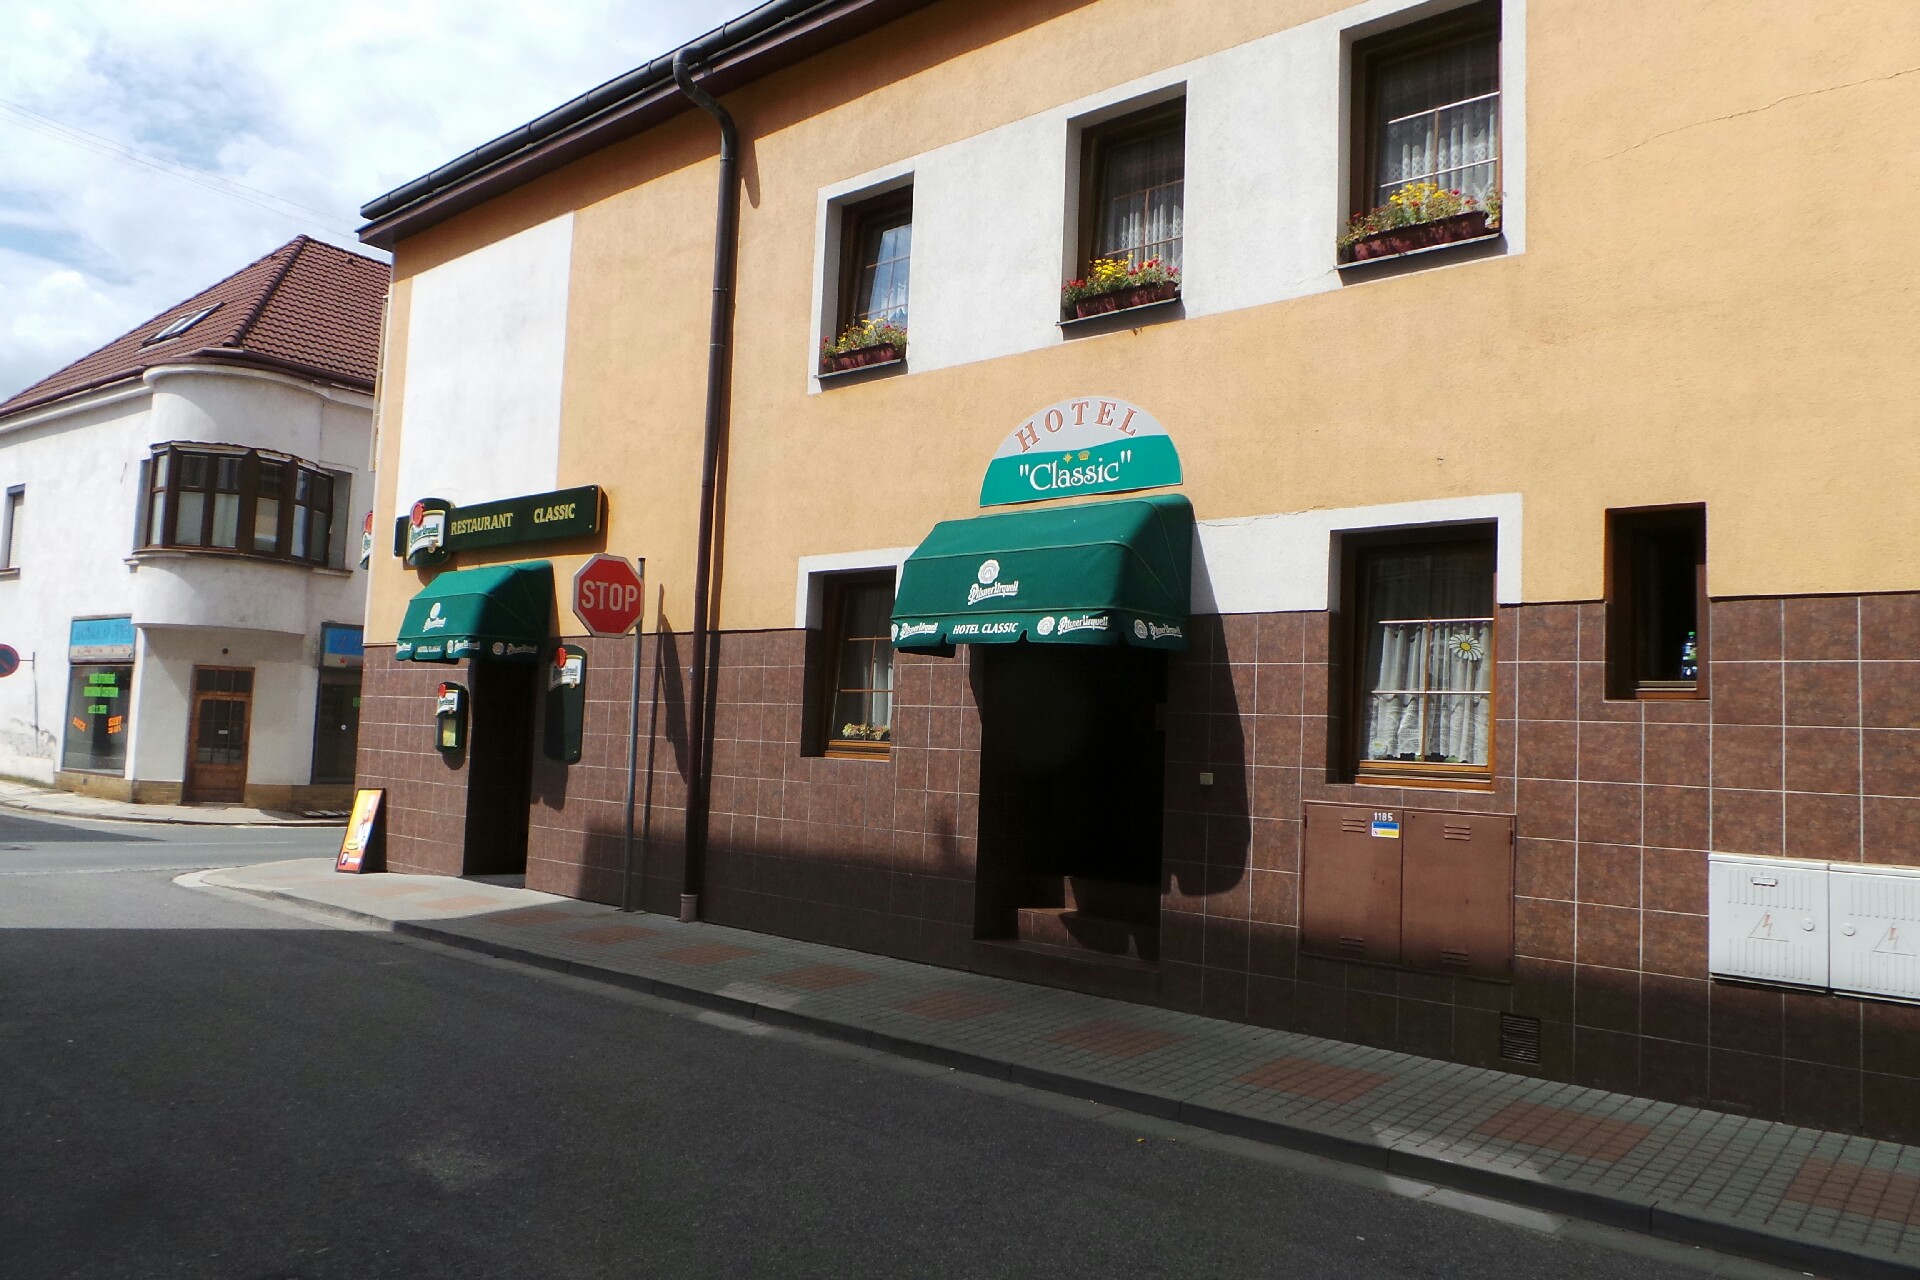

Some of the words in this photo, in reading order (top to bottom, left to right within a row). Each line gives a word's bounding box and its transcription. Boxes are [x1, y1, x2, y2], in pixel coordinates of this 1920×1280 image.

[1014, 400, 1138, 453] HOTEL
[451, 512, 514, 535] RESTAURANT
[533, 503, 576, 523] CLASSIC
[581, 580, 638, 612] STOP
[967, 583, 996, 606] Pilsner
[994, 580, 1019, 599] Urquell
[952, 624, 980, 635] HOTEL
[981, 622, 1019, 634] CLASSIC
[1057, 616, 1083, 636] Pilsner
[1081, 614, 1108, 631] Urquell
[1374, 812, 1393, 822] 1185
